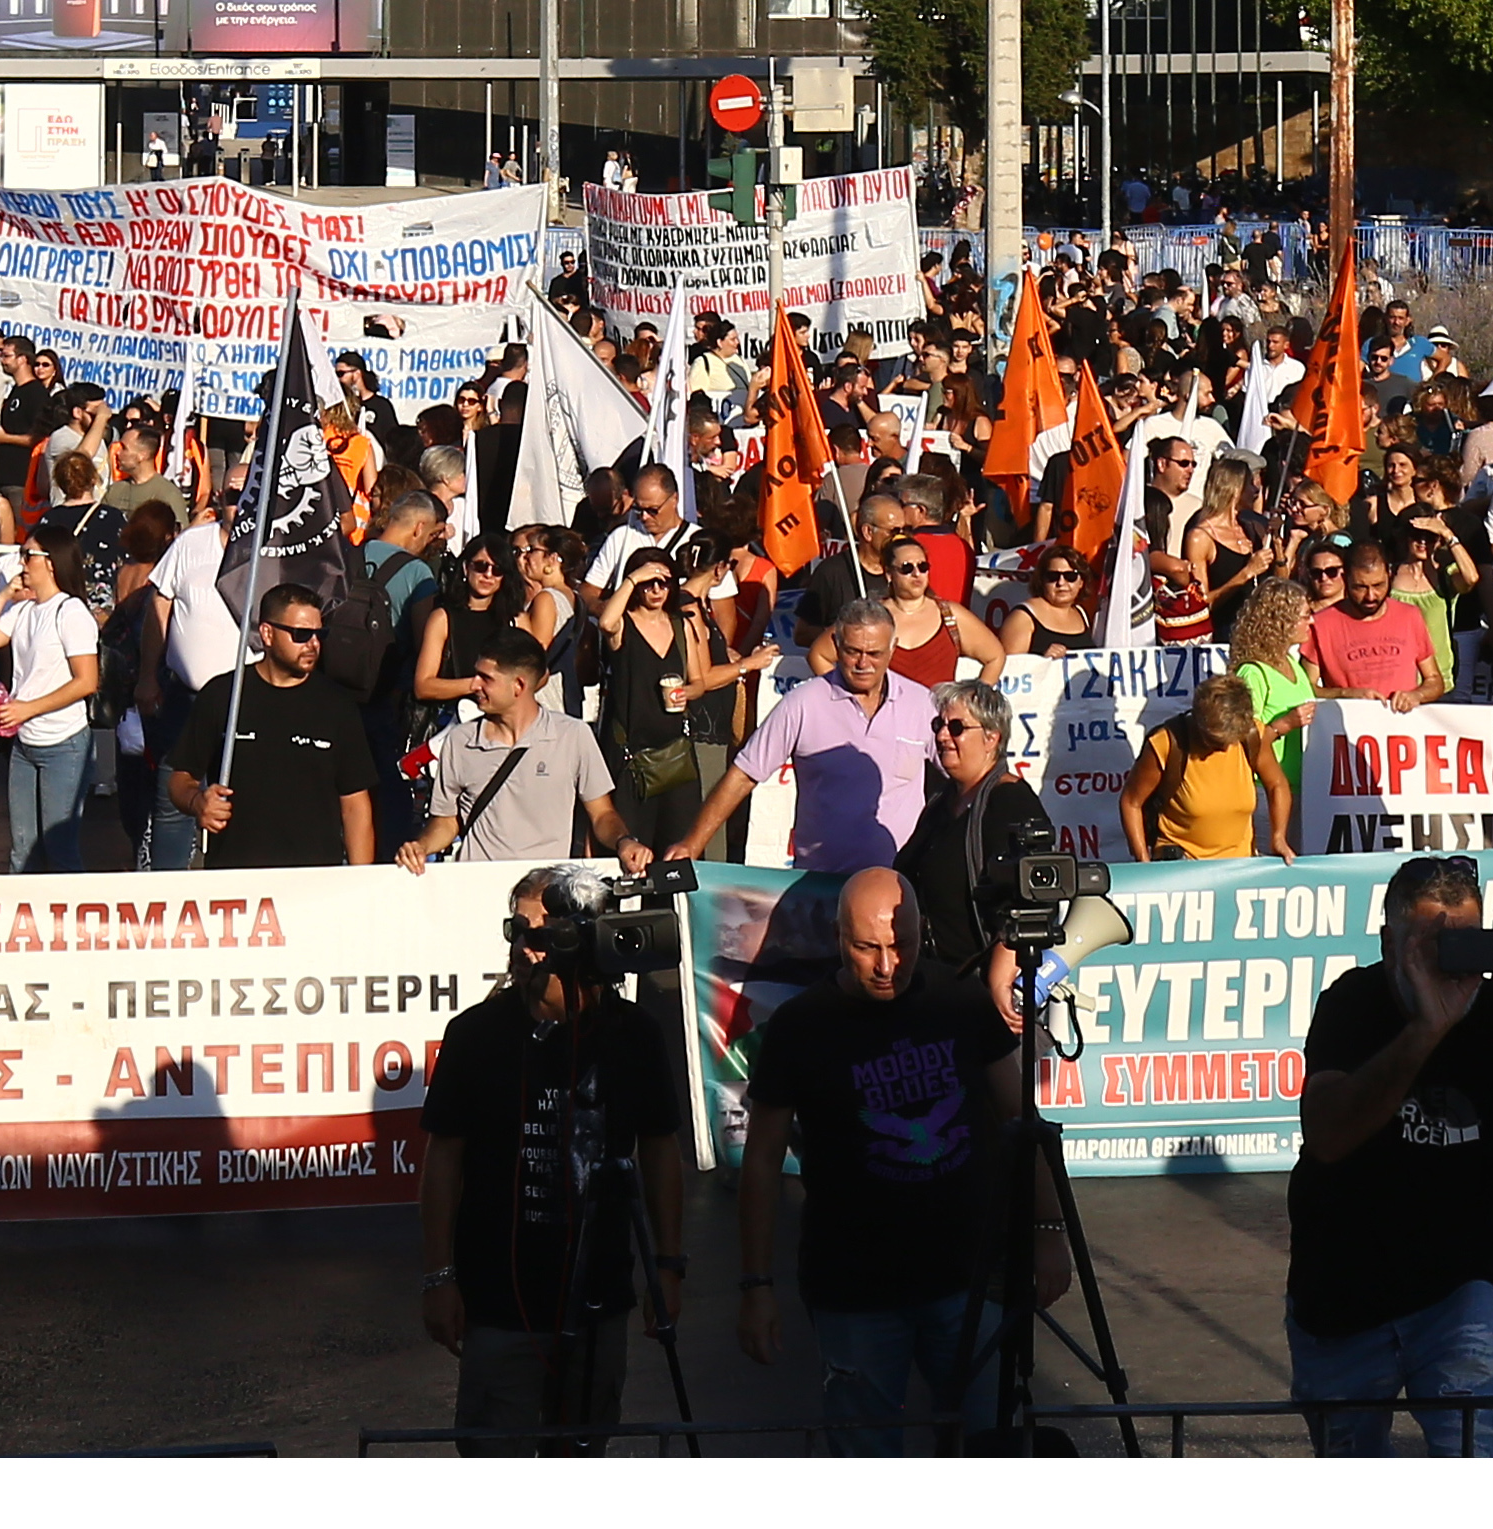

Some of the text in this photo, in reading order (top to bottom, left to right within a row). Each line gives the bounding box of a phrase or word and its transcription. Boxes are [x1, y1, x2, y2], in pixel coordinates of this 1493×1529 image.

[215, 17, 227, 27] με
[230, 16, 248, 27] την
[227, 2, 254, 15] δικός
[256, 4, 275, 13] σου
[278, 2, 317, 16] τρόπος
[48, 114, 73, 123] ΕΔΩ
[48, 126, 79, 134] ΣΤΗΝ
[60, 192, 125, 220] ΤΟΥΣ
[187, 181, 292, 230] ΣΠΟΥΔΕΣ
[301, 212, 364, 243] ΜΑΣ!
[1347, 644, 1400, 662] GRAND
[1067, 717, 1128, 753] μας
[1234, 884, 1346, 940] ΣΤΟΝ
[108, 973, 458, 1019] ΠΕΡΙΣΣΟΤΕΡΗ
[851, 1039, 956, 1090] MOODY
[1101, 1048, 1307, 1108] ΣΥΜΜΕΤΟ
[864, 1066, 960, 1112] BLUES
[1152, 1132, 1278, 1157] ΘΕΣΣΑΛΟΝΙΚΗΣ
[47, 1150, 202, 1193] ΝΑΥΠ/ΣΤΙΚΗΣ
[218, 1141, 377, 1185] ΒΙΟΜΗΧΑΝΙΑΣ
[392, 1140, 416, 1176] Κ.
